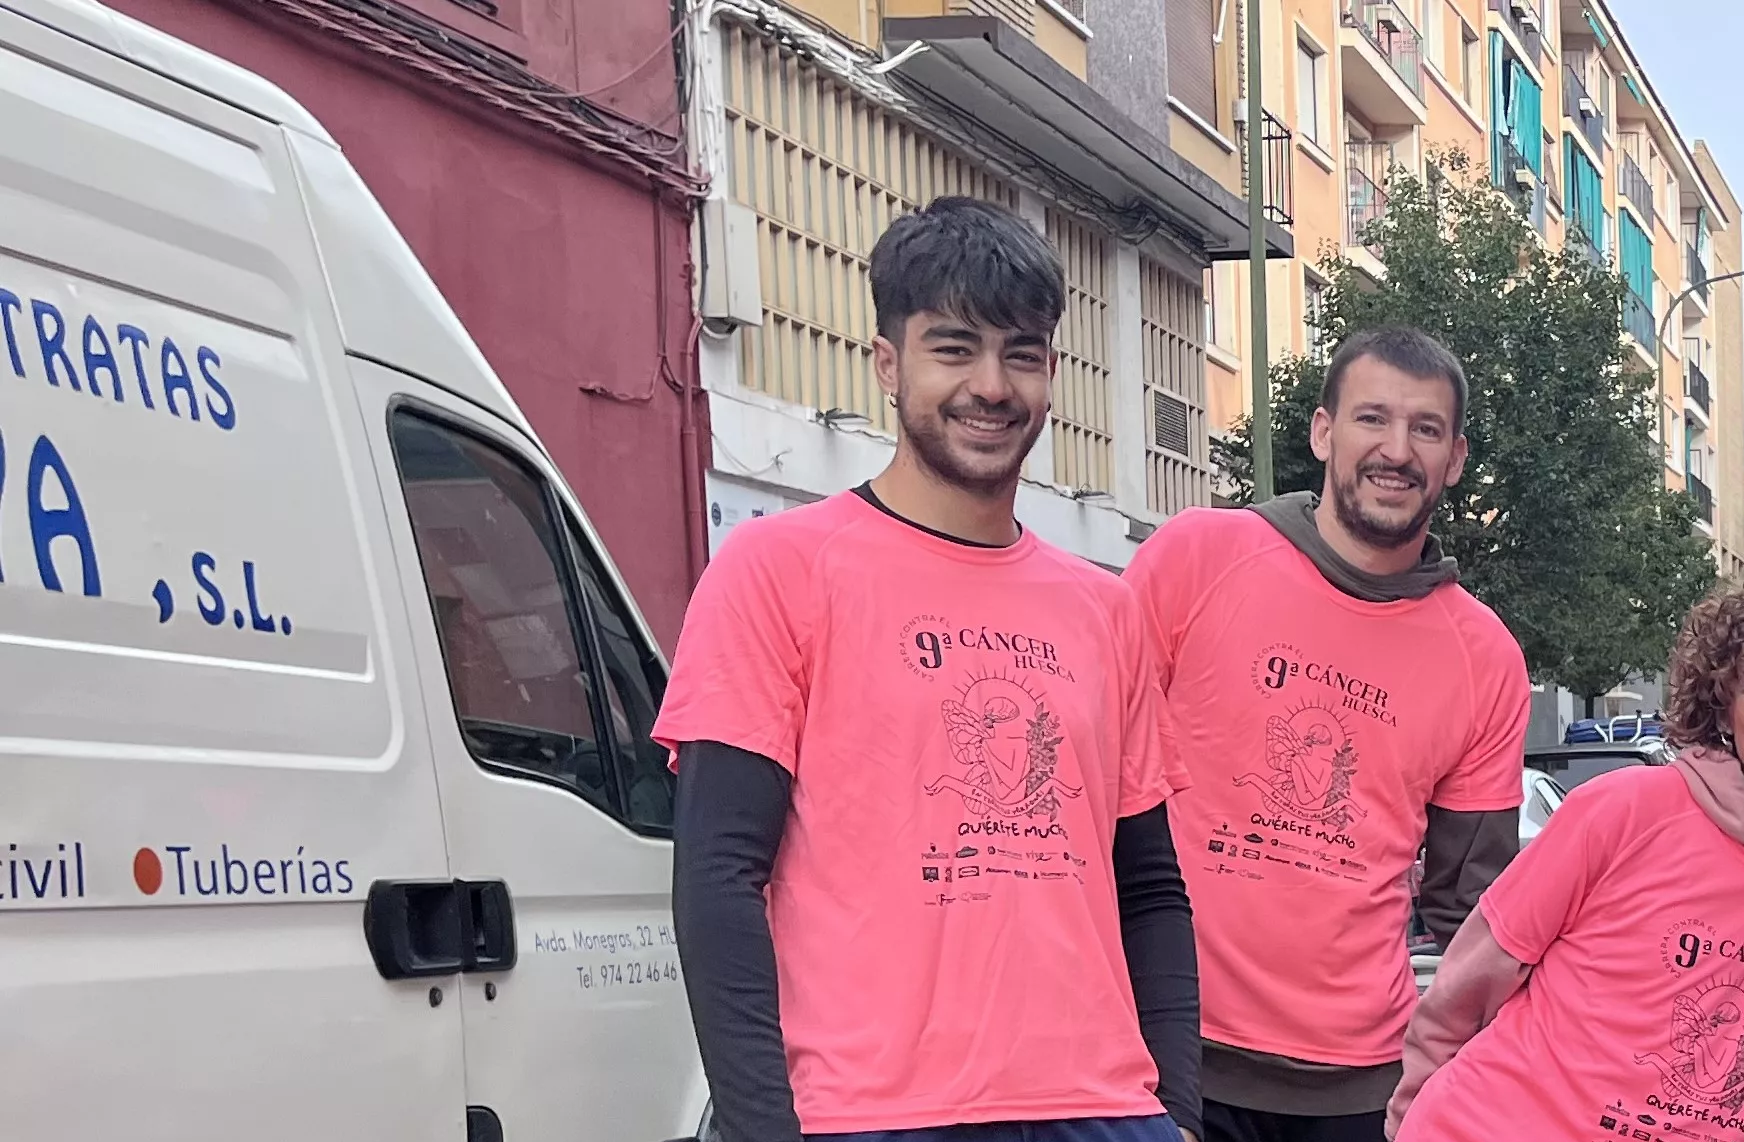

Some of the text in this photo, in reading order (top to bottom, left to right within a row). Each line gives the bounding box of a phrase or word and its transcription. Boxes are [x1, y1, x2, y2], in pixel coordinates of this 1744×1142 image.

[0, 430, 102, 597] A
[915, 626, 1057, 669] 9ª CÁNCER
[1014, 654, 1076, 683] HUESCA
[1264, 656, 1388, 708] 9ª CÁNCER
[1342, 694, 1397, 727] HUESCA
[1250, 812, 1356, 849] QUIÉRETE MUCHO
[0, 842, 84, 898] ivil
[166, 844, 353, 895] Tuberías
[636, 925, 654, 948] 32
[1675, 933, 1713, 968] 9ª
[600, 964, 623, 987] 974
[627, 961, 642, 984] 22
[646, 961, 660, 983] 46
[663, 961, 677, 982] 46
[1646, 1095, 1710, 1120] QUIÉRETE
